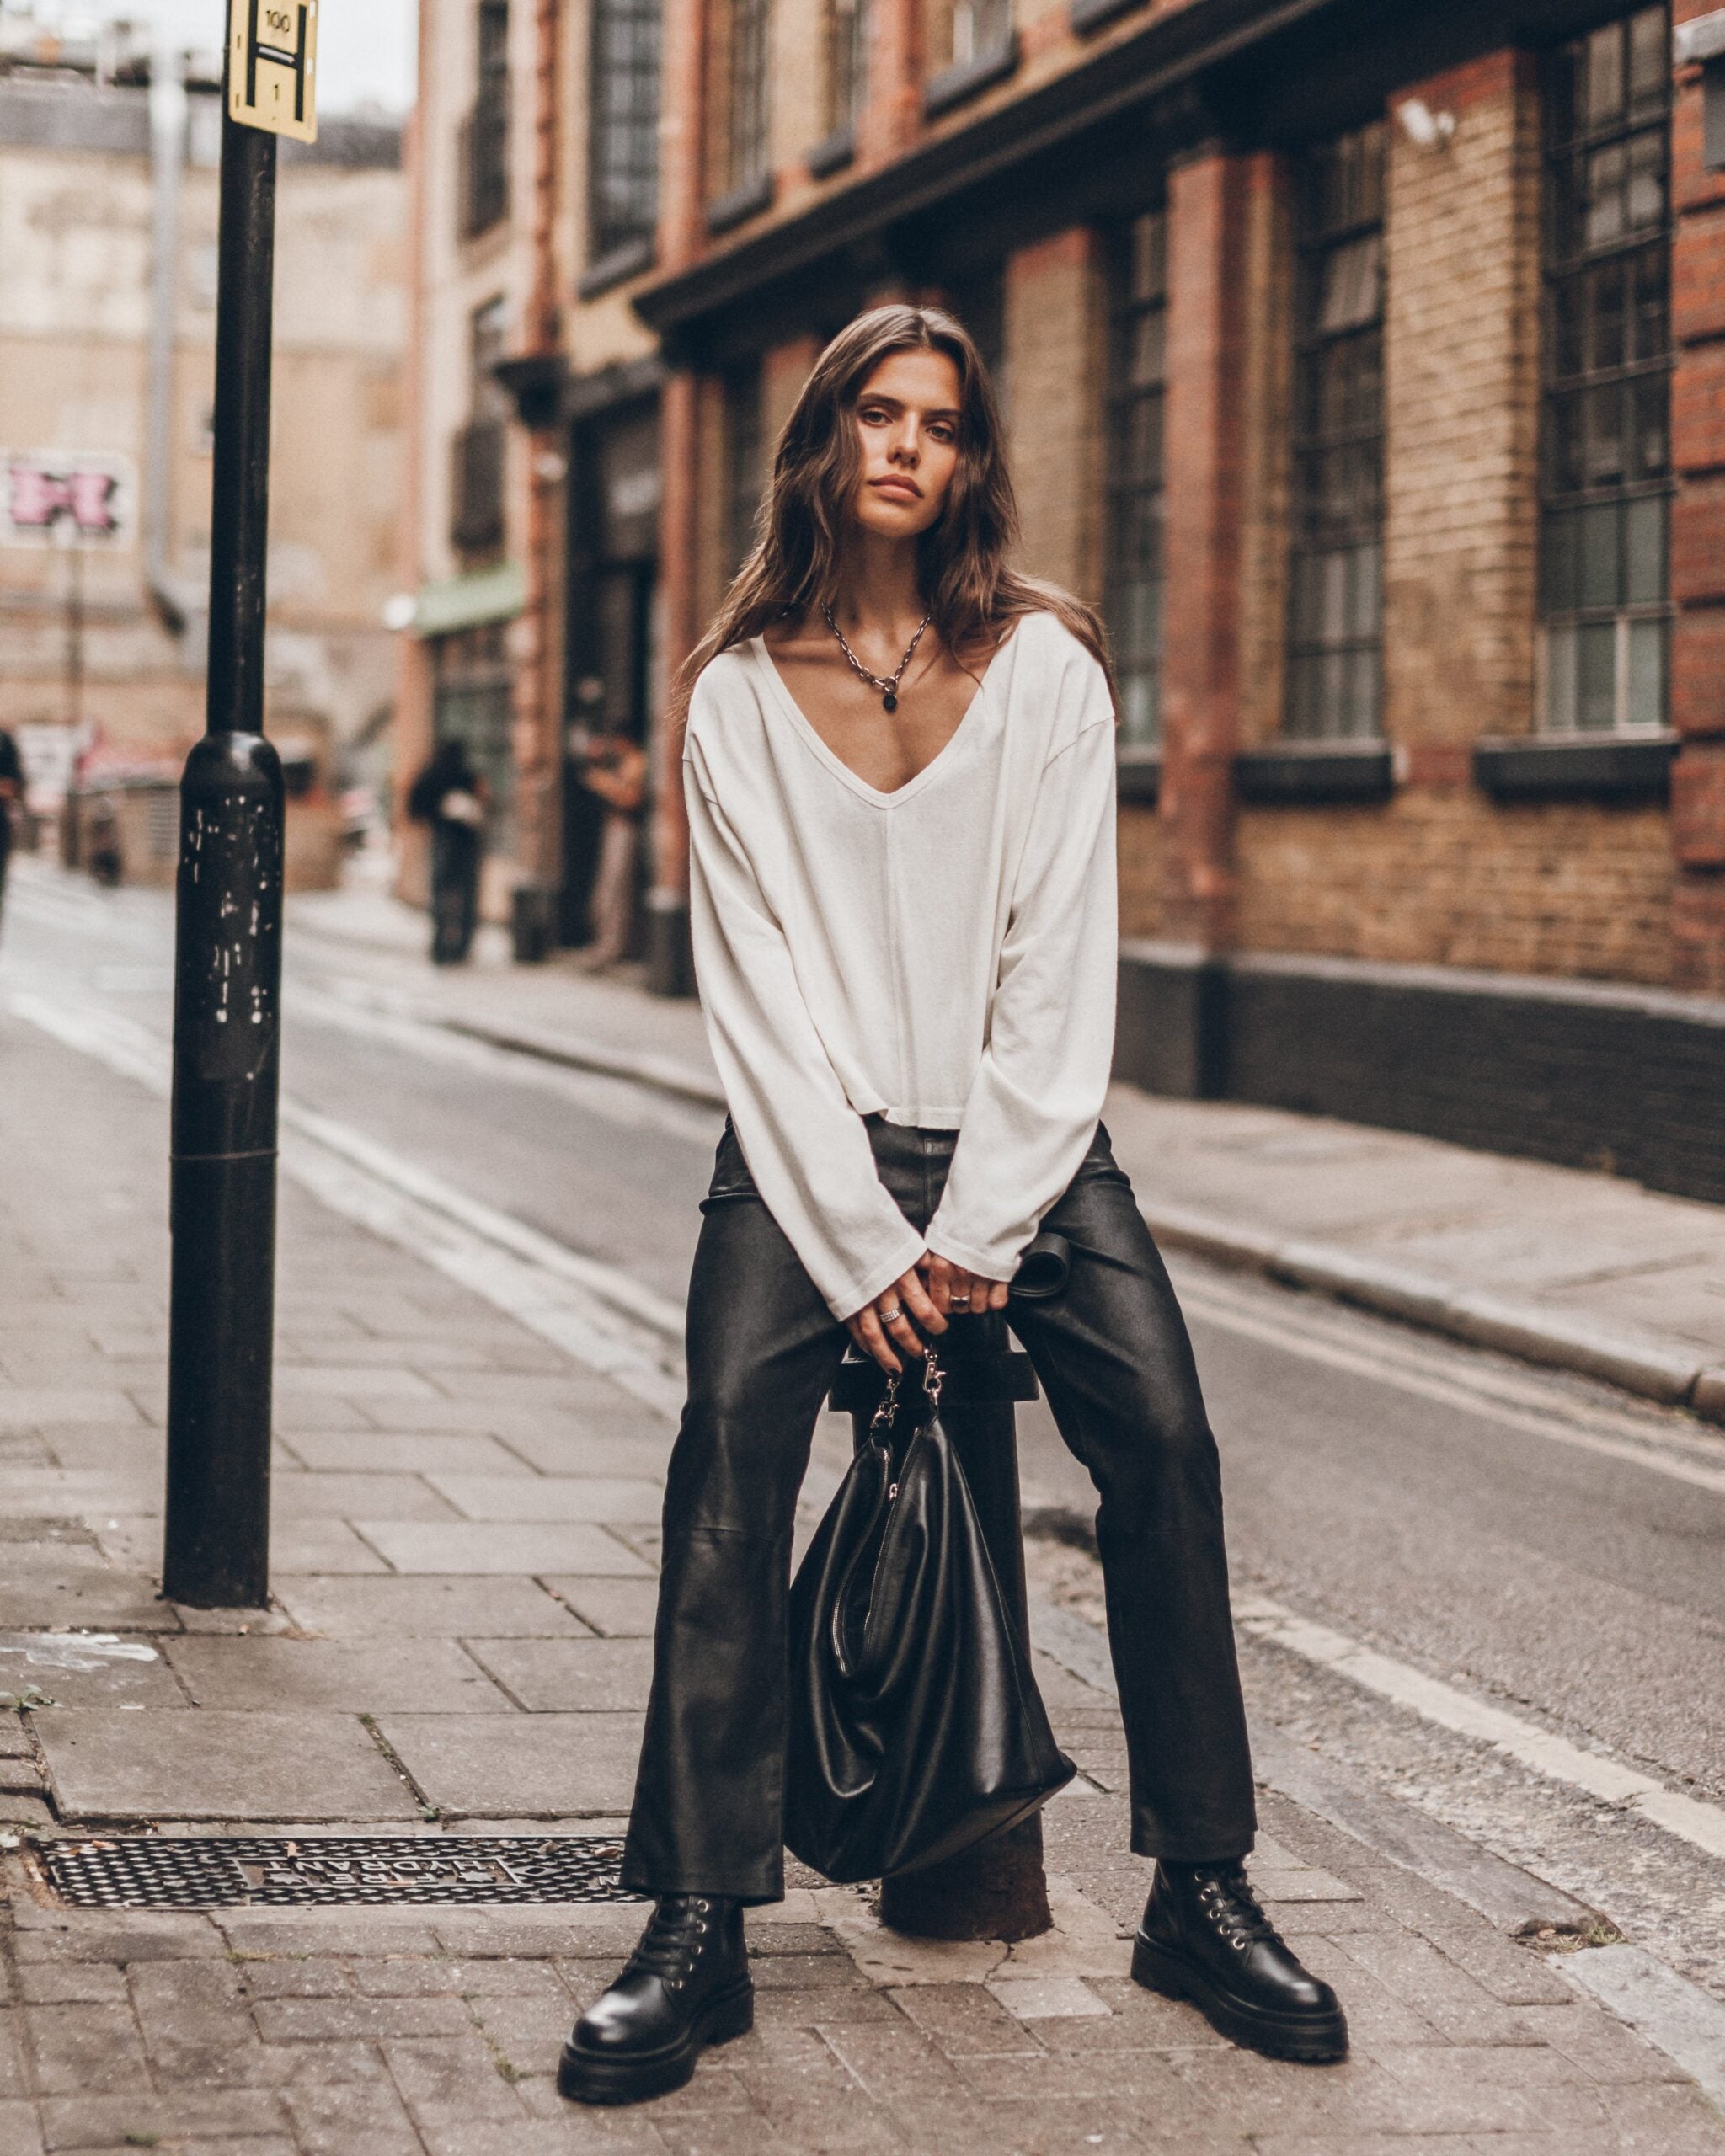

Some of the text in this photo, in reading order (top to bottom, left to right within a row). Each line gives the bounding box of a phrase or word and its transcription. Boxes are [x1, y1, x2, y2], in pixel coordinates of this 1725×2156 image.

[265, 9, 291, 33] 100
[274, 83, 280, 101] 1
[264, 1860, 487, 1871] HYDRANT
[326, 1872, 438, 1884] FIRE
